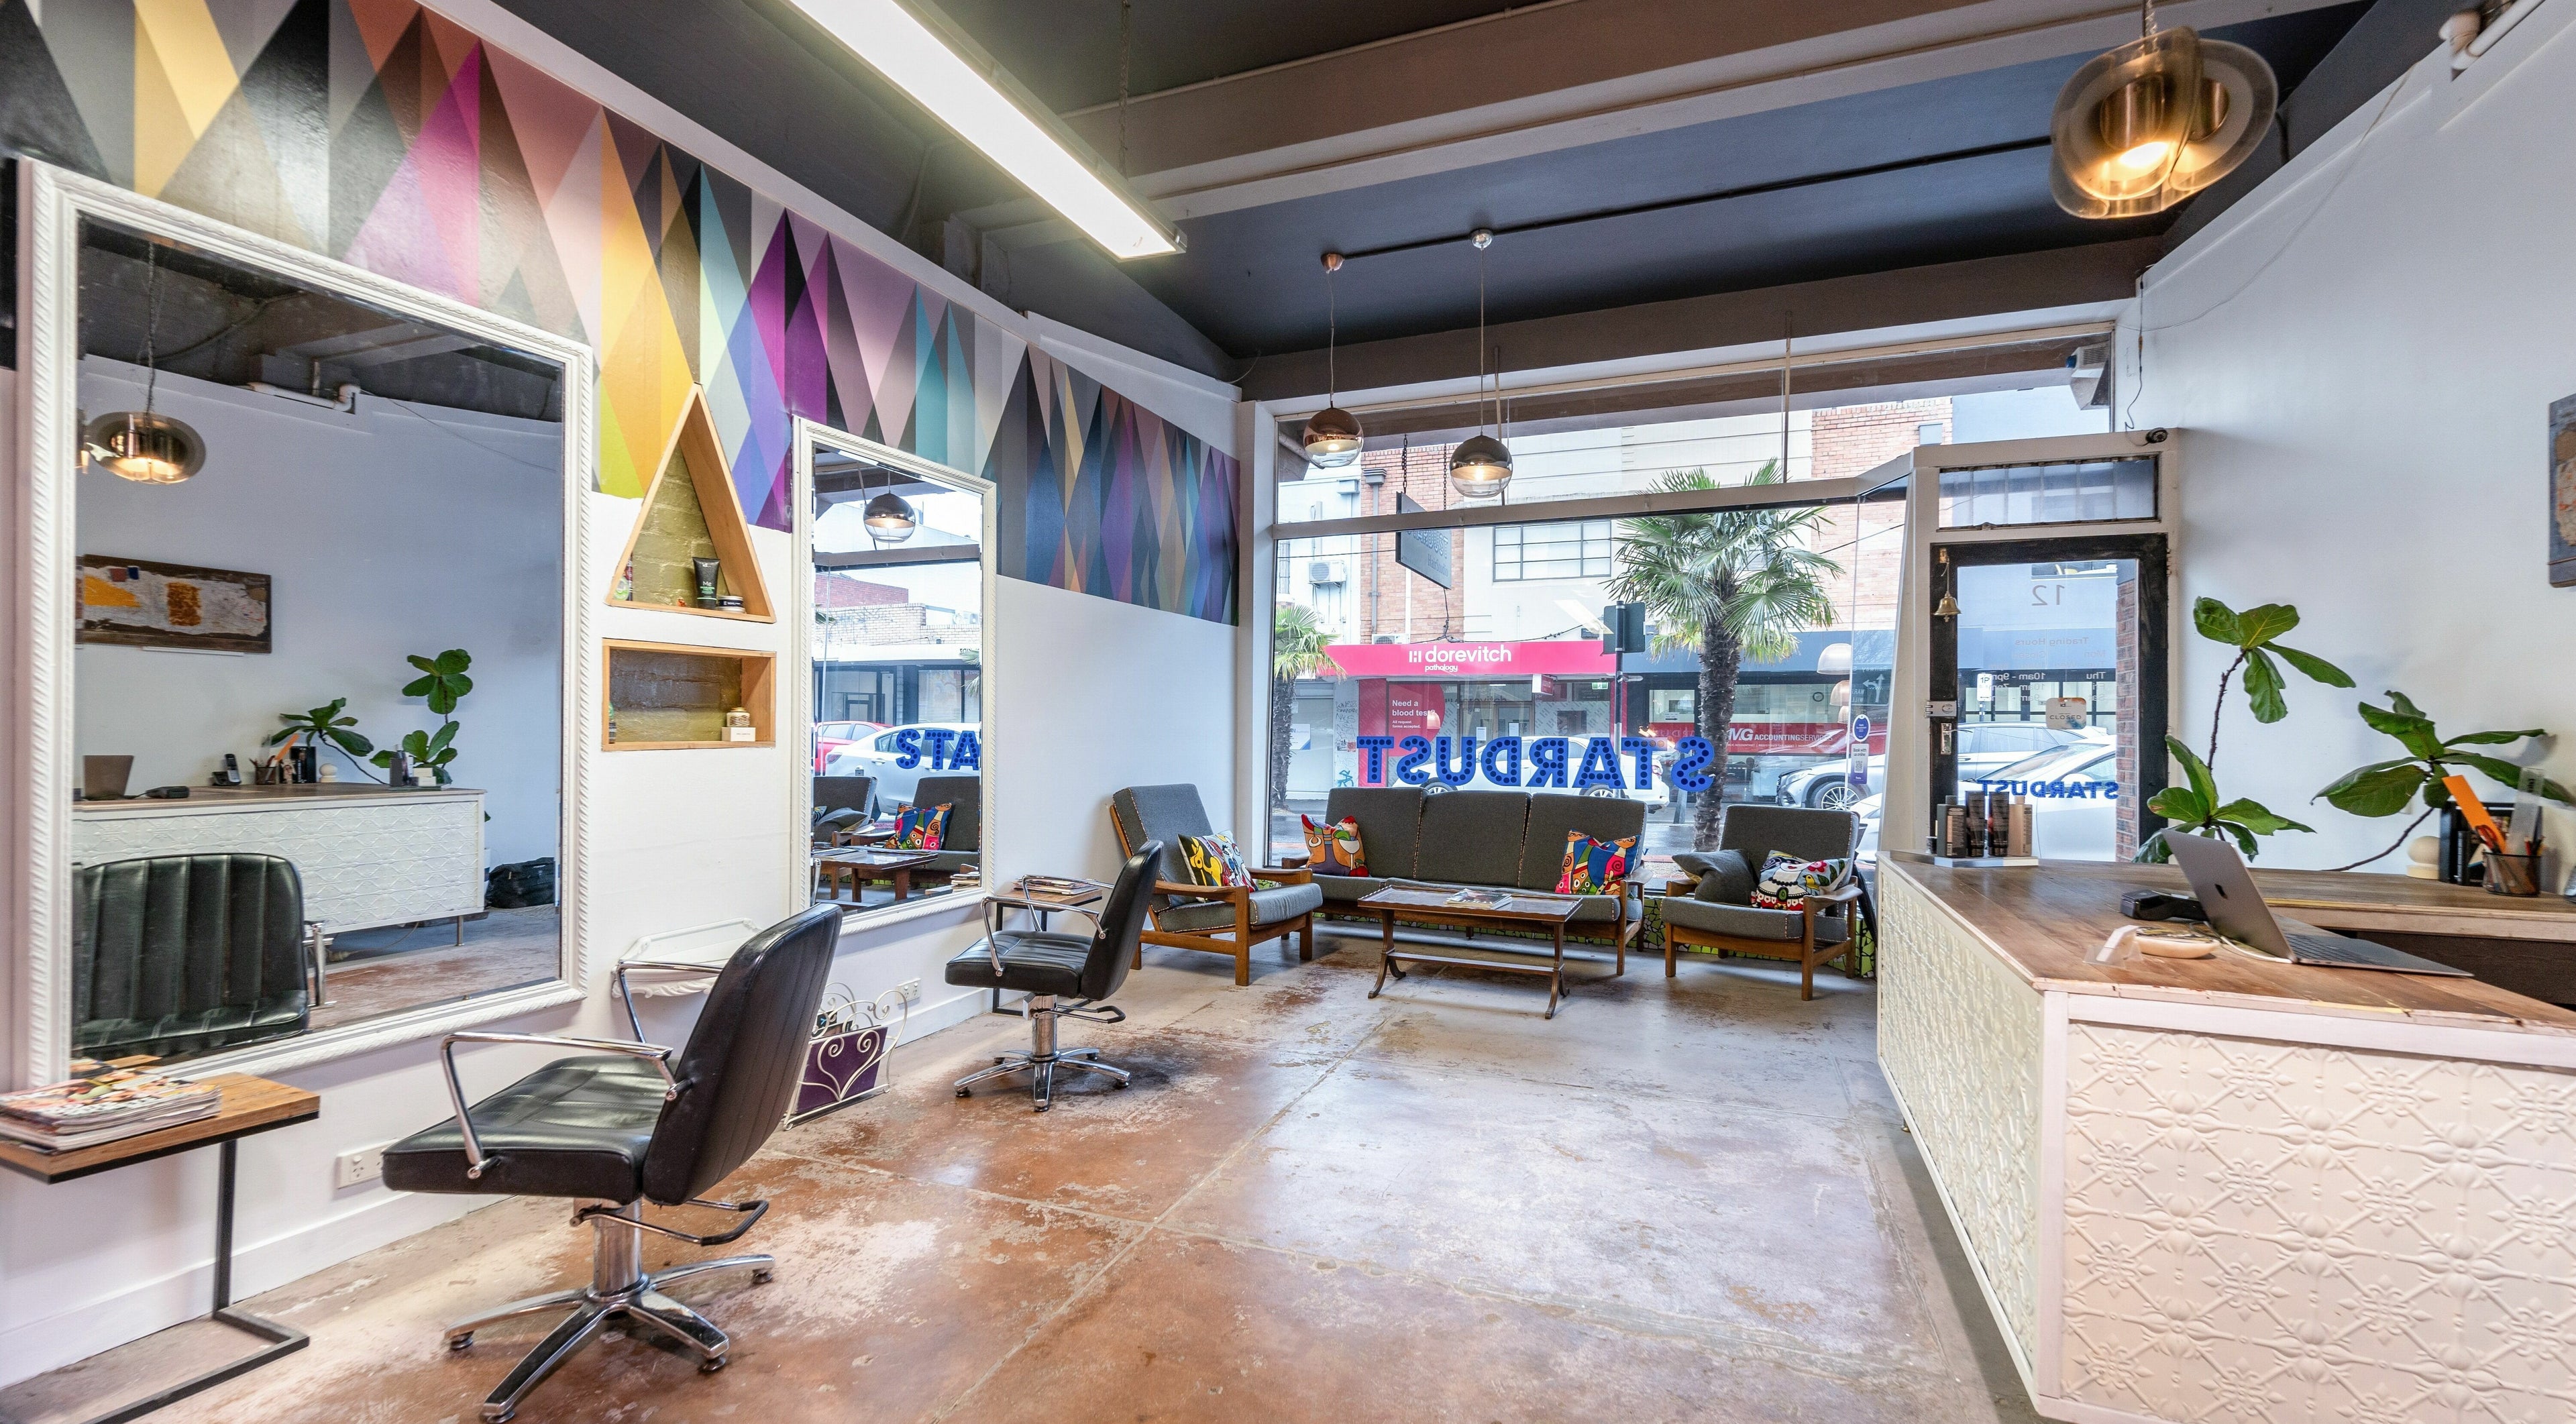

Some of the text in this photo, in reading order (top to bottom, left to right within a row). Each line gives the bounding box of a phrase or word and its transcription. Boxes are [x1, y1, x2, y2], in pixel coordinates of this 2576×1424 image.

[1407, 529, 1449, 559] ARDUST
[1424, 644, 1512, 663] dorevitch
[1424, 664, 1458, 673] pathology
